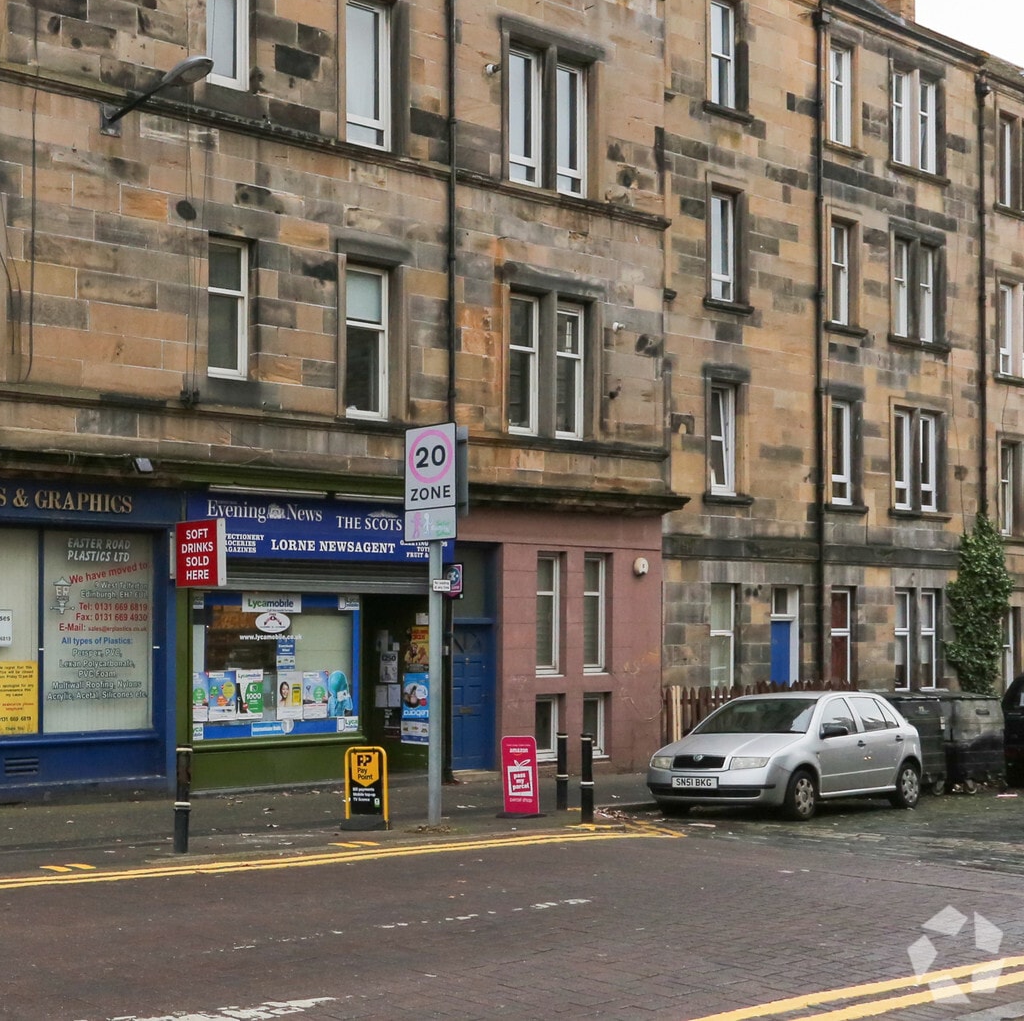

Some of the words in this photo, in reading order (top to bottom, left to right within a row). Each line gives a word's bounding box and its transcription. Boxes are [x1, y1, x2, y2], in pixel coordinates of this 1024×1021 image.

[415, 445, 446, 468] 20
[410, 485, 451, 501] ZONE
[13, 488, 28, 507] &
[35, 490, 133, 513] GRAPHICS
[207, 500, 266, 522] Evening
[287, 504, 323, 521] News
[336, 516, 361, 529] THE
[364, 517, 402, 531] SCOTS
[186, 528, 208, 540] SOFT
[67, 538, 102, 549] EASTER
[105, 539, 131, 549] ROAD
[181, 541, 213, 554] DRINKS
[271, 539, 315, 551] LORNE
[319, 541, 396, 554] NEWSAGENT
[67, 551, 112, 562] PLASTICS
[113, 552, 130, 562] LTD
[186, 555, 209, 567] SOLD
[69, 575, 83, 584] We
[85, 571, 106, 581] have
[108, 563, 137, 576] moved
[186, 569, 209, 580] HERE
[79, 602, 93, 610] Tel:
[95, 602, 112, 610] 0131
[248, 599, 294, 609] Lycamobile
[76, 613, 92, 621] Fax:
[95, 613, 112, 621] 0131
[59, 623, 86, 631] E-Mail:
[73, 638, 92, 646] types
[676, 778, 693, 786] SN51
